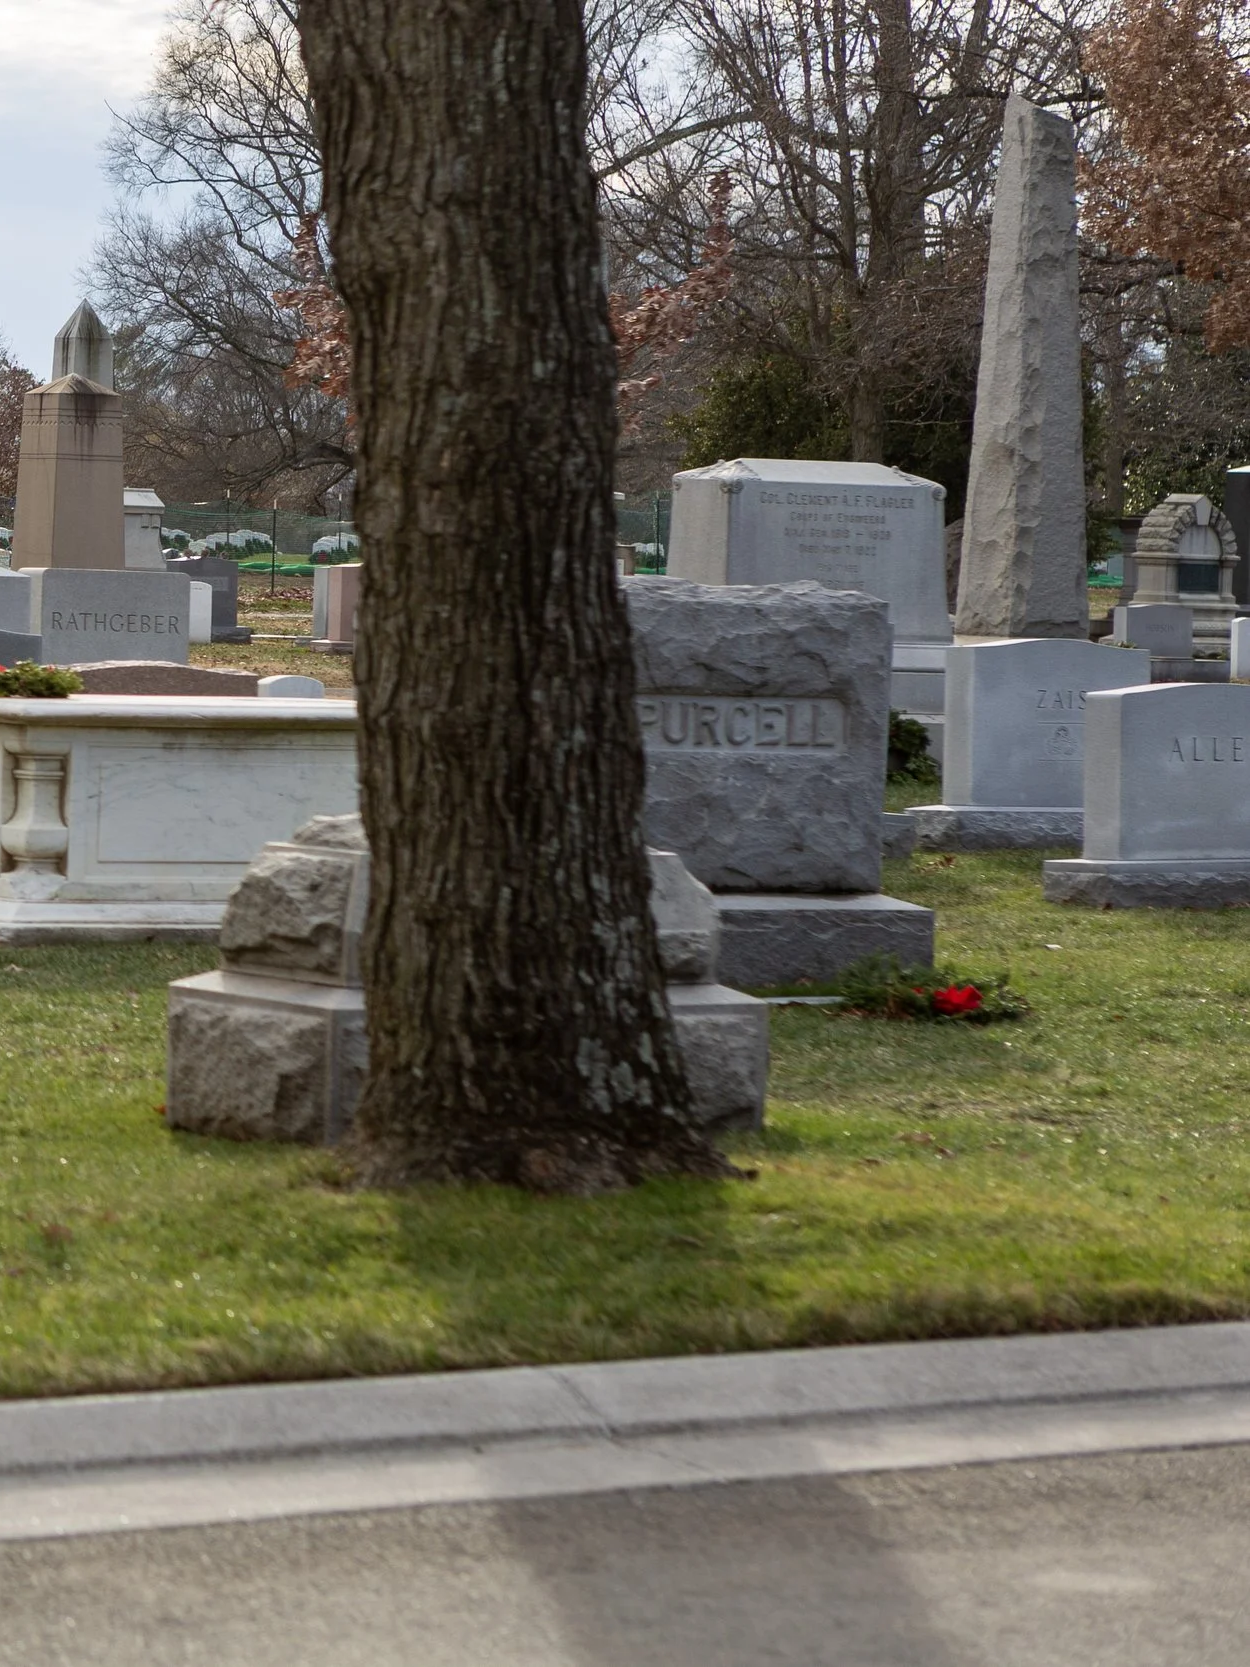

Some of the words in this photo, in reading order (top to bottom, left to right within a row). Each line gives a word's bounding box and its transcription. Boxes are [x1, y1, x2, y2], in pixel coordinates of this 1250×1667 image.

[786, 492, 839, 506] CLEMENT
[865, 494, 915, 509] FLAGLER
[51, 611, 181, 635] RATHGEBER
[1036, 688, 1087, 710] ZAIS
[638, 700, 835, 748] PURCELL
